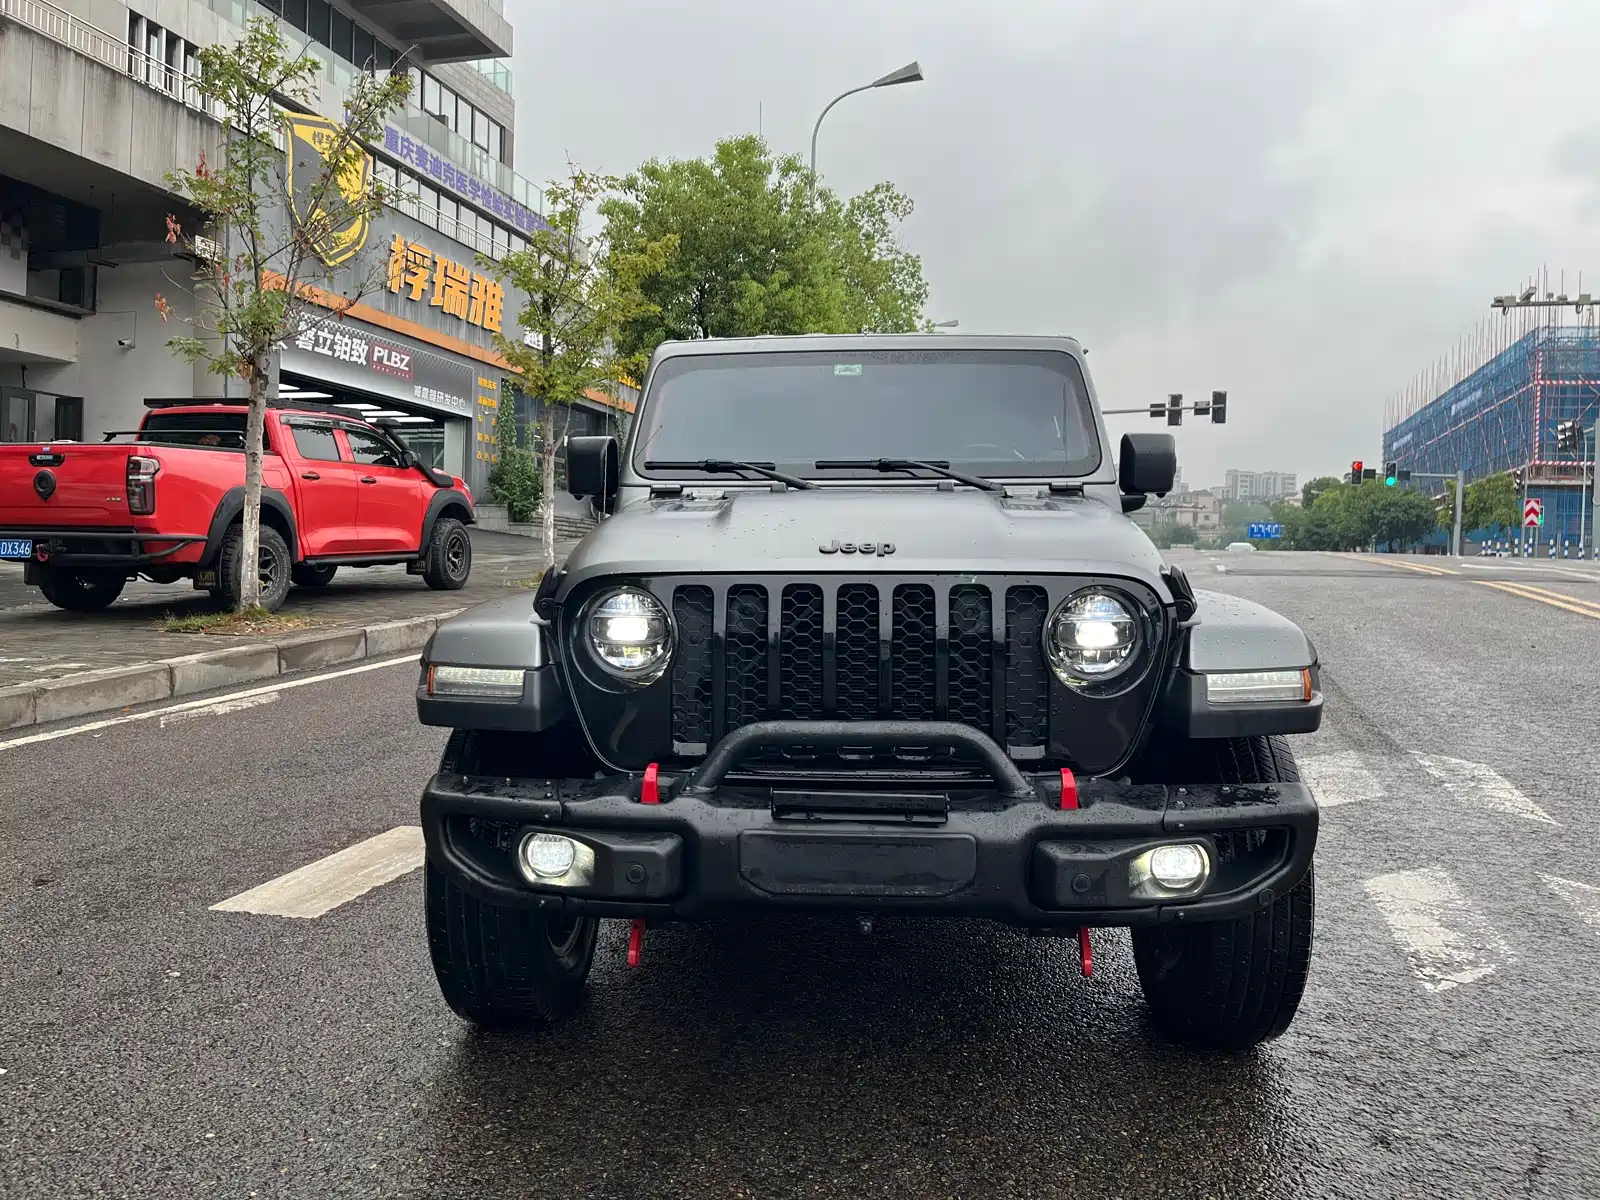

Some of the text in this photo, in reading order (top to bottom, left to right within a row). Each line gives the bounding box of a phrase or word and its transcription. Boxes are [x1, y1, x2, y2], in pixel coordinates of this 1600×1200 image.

[373, 346, 410, 371] PLBZ
[413, 385, 466, 410] 减震器研发中心
[1, 542, 30, 555] DX346
[818, 539, 897, 557] Jeep
